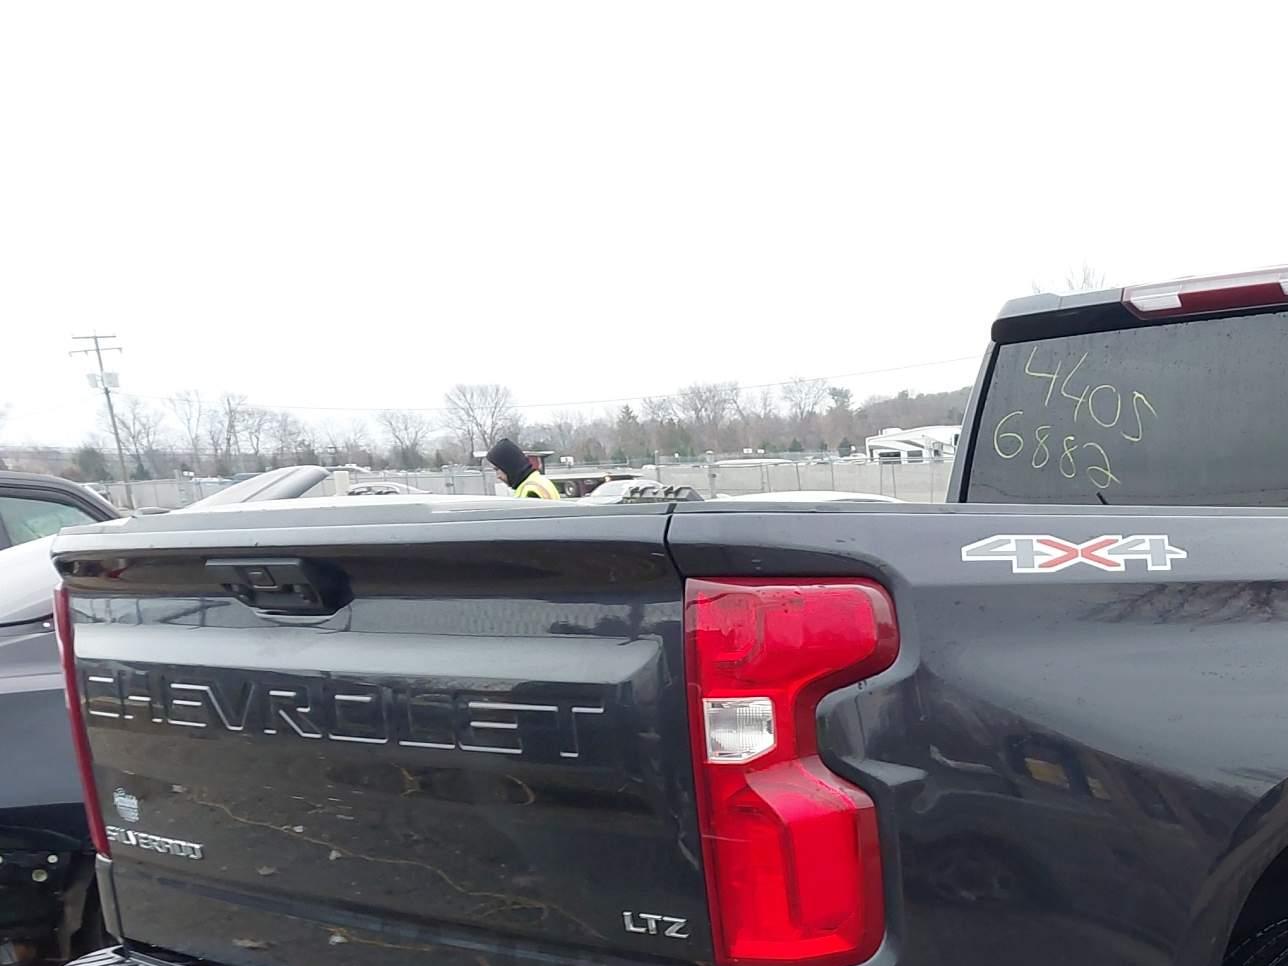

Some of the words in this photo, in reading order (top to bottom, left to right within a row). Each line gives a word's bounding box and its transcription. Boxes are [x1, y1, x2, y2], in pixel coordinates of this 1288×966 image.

[1024, 346, 1158, 442] 4405
[993, 410, 1122, 489] 6882
[86, 672, 606, 758] CHEVROLET
[104, 825, 205, 861] SILVERADO
[622, 911, 691, 939] LTZ
